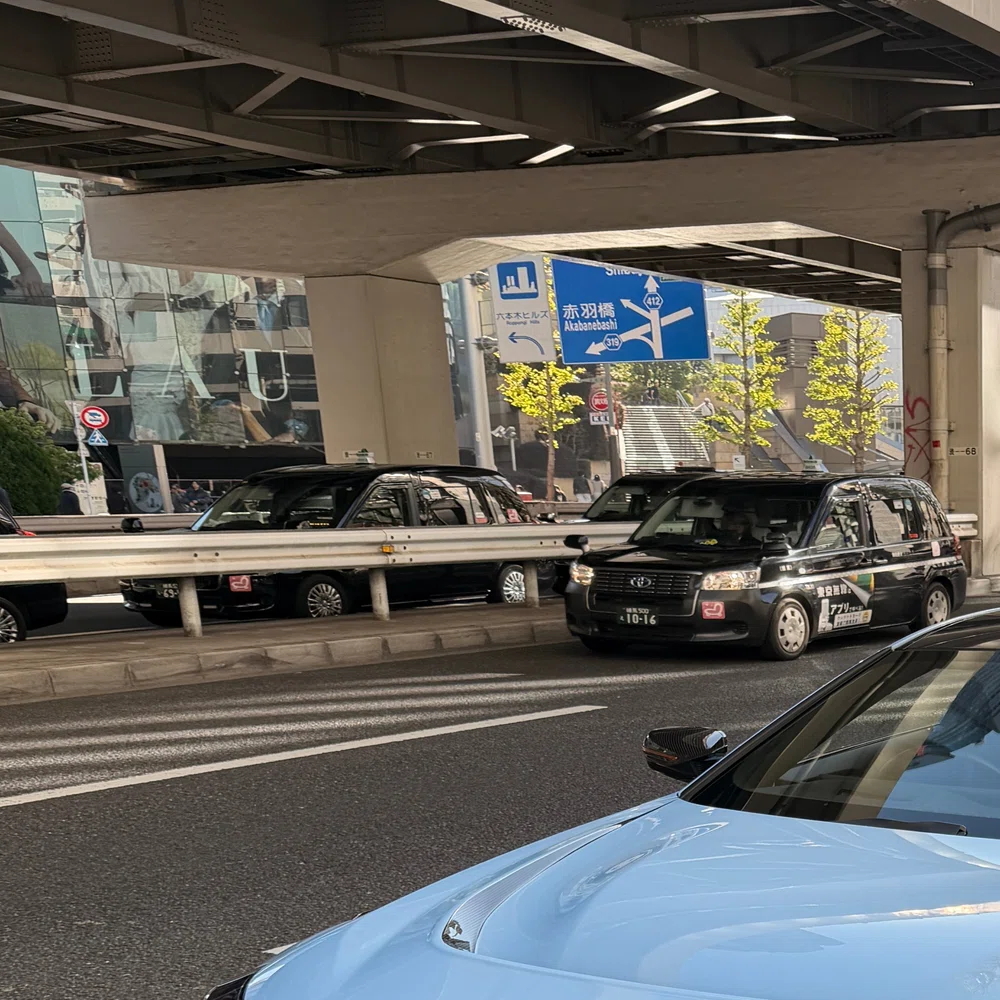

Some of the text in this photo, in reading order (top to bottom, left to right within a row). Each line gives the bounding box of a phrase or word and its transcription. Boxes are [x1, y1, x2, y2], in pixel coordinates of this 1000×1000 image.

[646, 296, 661, 306] 412
[496, 310, 549, 320] 六本木ヒルズ
[562, 302, 615, 319] 赤羽橋
[564, 318, 618, 332] Akabanebashi
[606, 336, 620, 347] 319
[65, 343, 291, 402] LAU
[626, 613, 657, 625] 10-16
